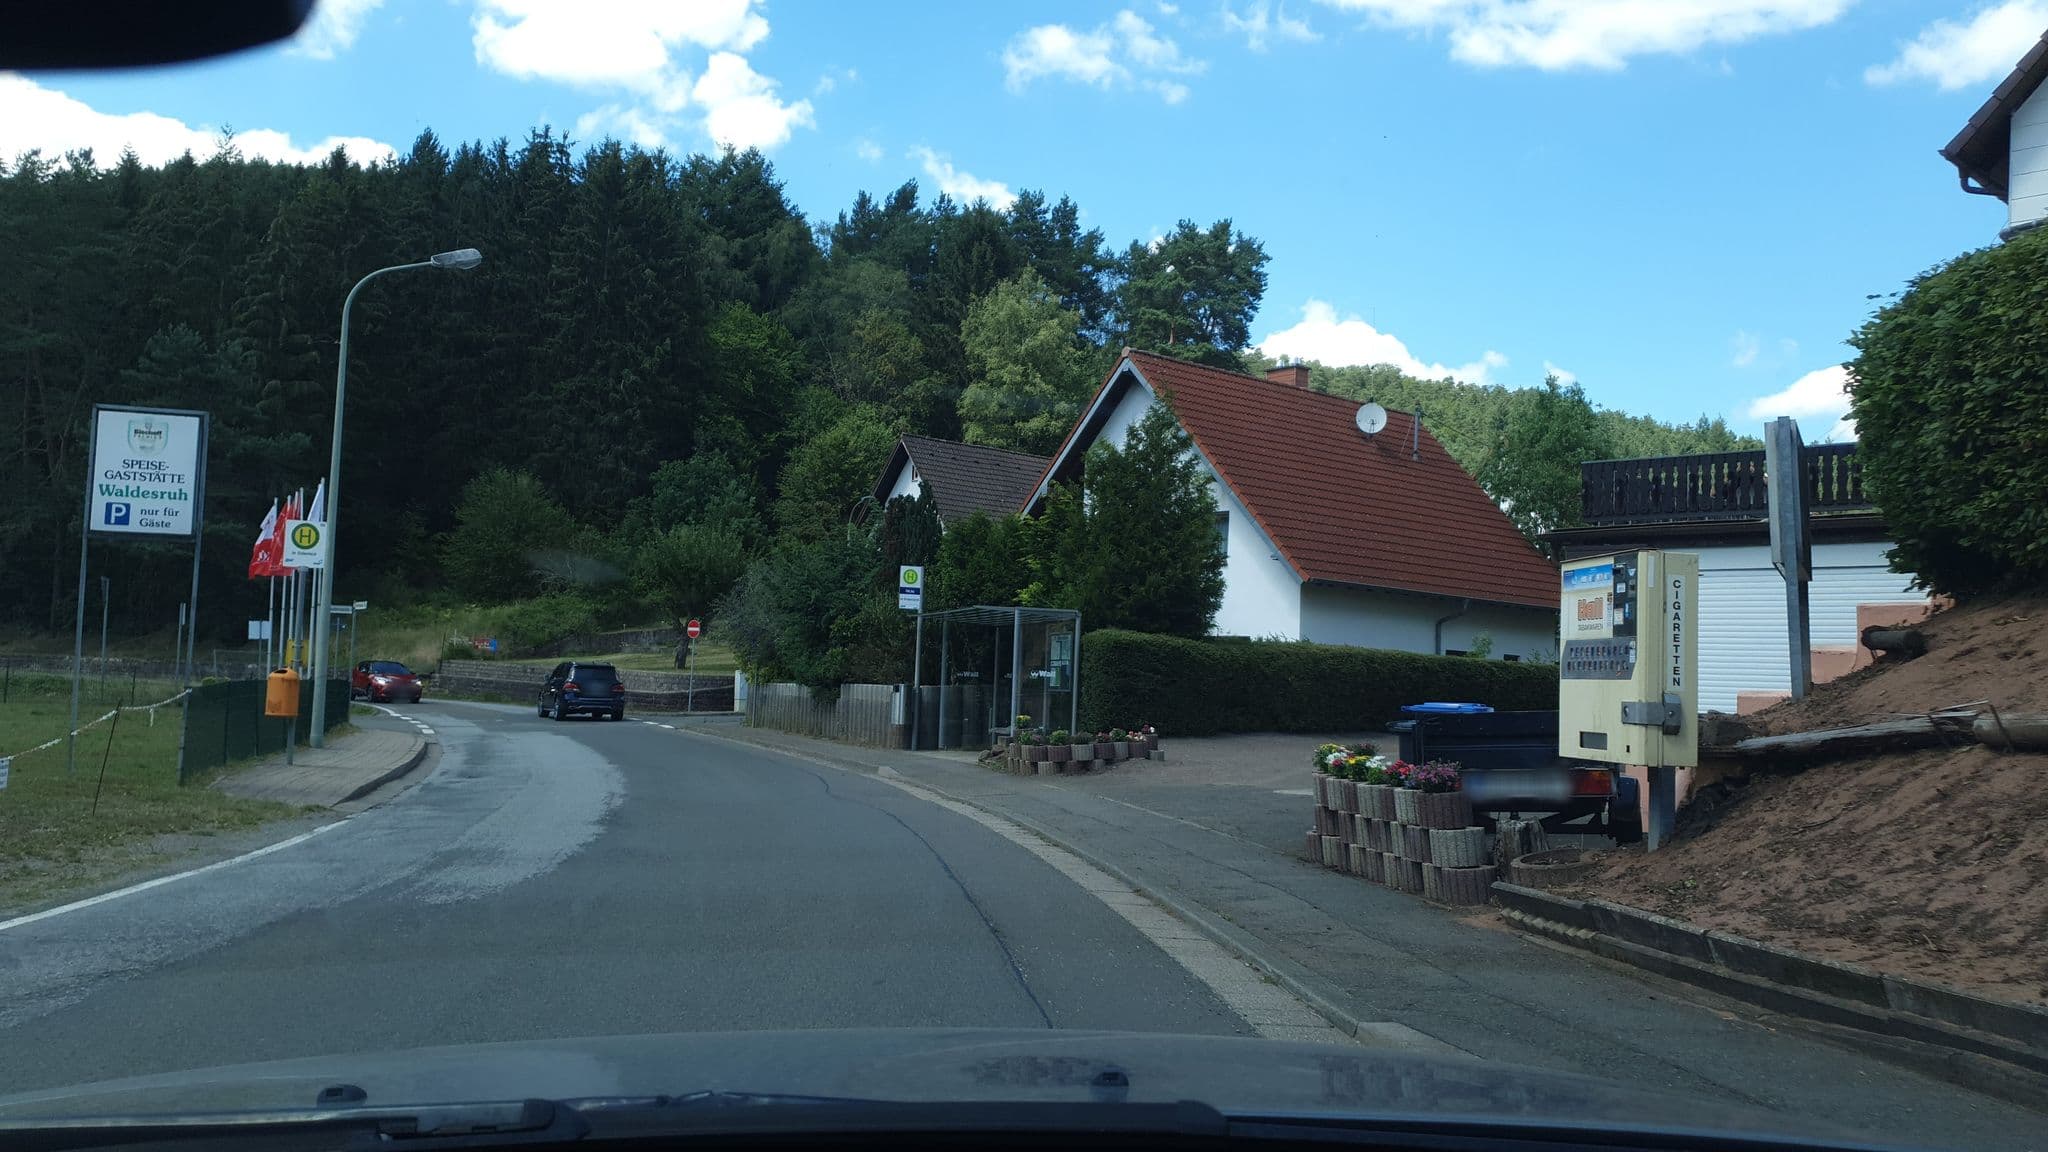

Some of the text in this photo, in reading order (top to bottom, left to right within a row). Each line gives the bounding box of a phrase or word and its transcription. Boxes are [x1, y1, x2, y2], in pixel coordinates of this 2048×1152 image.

[122, 458, 169, 470] SPEISE-
[104, 469, 185, 484] GASTSTÄTTE
[98, 483, 188, 501] Waldesruh
[110, 504, 126, 524] P
[140, 507, 180, 517] nur für
[139, 518, 171, 528] Gäste
[299, 528, 312, 544] H
[1672, 579, 1681, 687] CIGARETTEN
